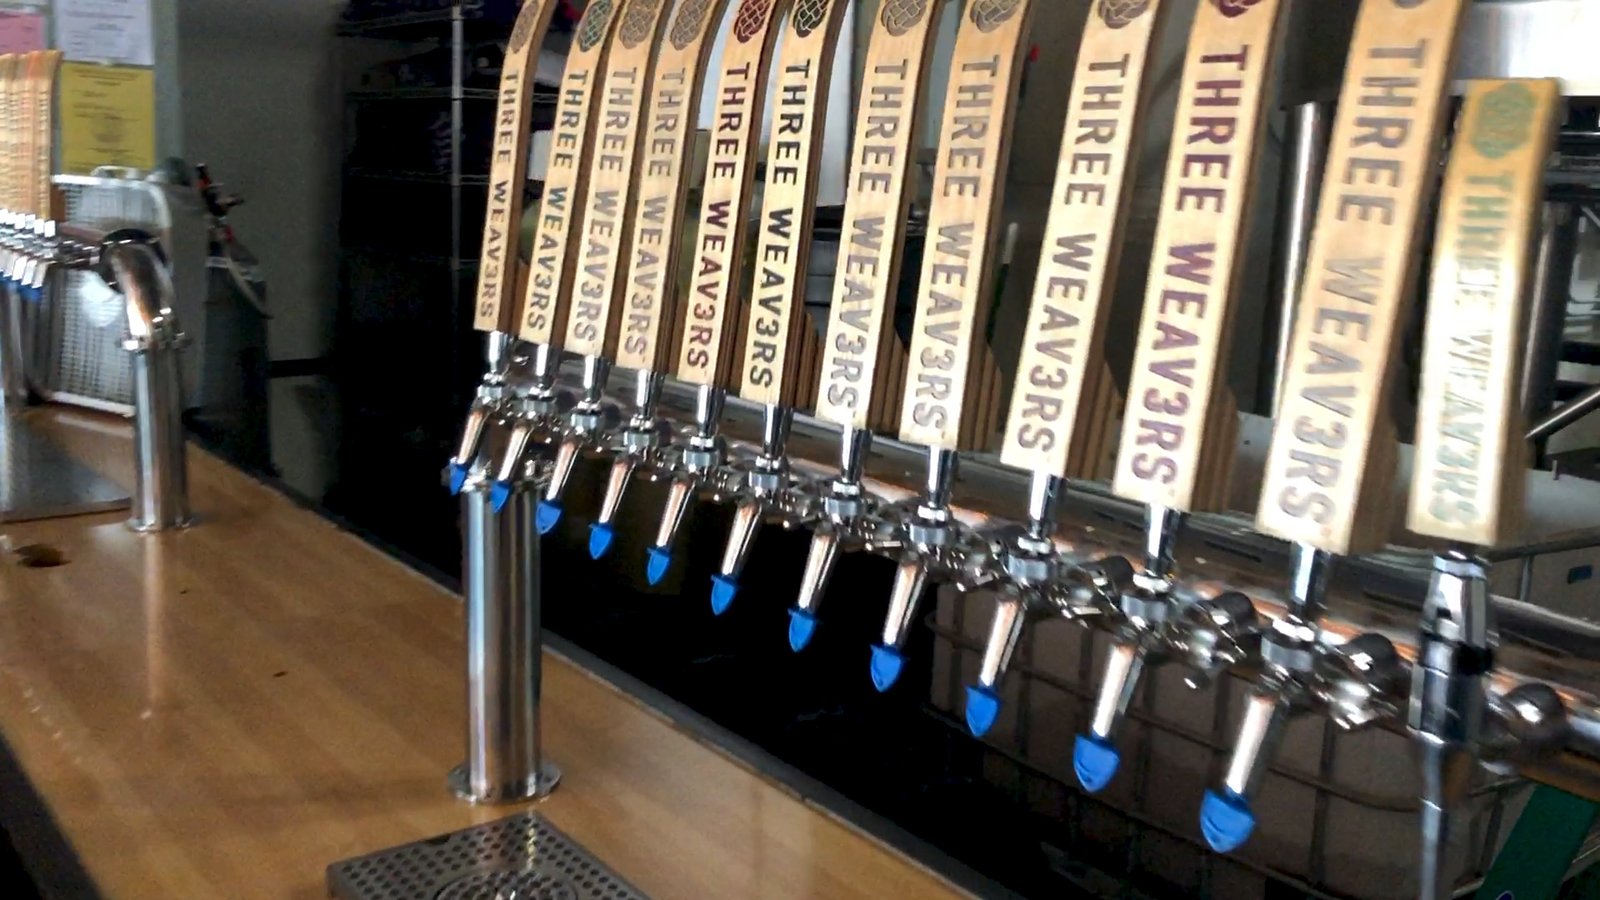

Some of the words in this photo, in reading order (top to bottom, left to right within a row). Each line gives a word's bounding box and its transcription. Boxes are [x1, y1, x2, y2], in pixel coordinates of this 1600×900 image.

[497, 70, 519, 164] THREE
[553, 69, 590, 169] THREE
[599, 67, 637, 172] THREE
[649, 67, 686, 177] THREE
[713, 62, 750, 179] THREE
[773, 58, 810, 185] THREE
[858, 58, 908, 193] THREE
[943, 54, 999, 197] THREE
[1064, 53, 1130, 206] THREE
[1175, 44, 1251, 213] THREE
[1335, 38, 1427, 226] THREE
[527, 186, 568, 331] WEAV3RS
[573, 190, 620, 342] WEAV3RS
[624, 195, 668, 356] WEAV3RS
[687, 200, 731, 370] WEAV3RS
[749, 207, 793, 388] WEAV3RS
[828, 216, 885, 408] WEAV3RS
[913, 222, 975, 429] WEAV3RS
[1017, 233, 1097, 452] WEAV3RS
[1131, 242, 1216, 484] WEAV3RS
[1277, 256, 1384, 532] WEAV3RS
